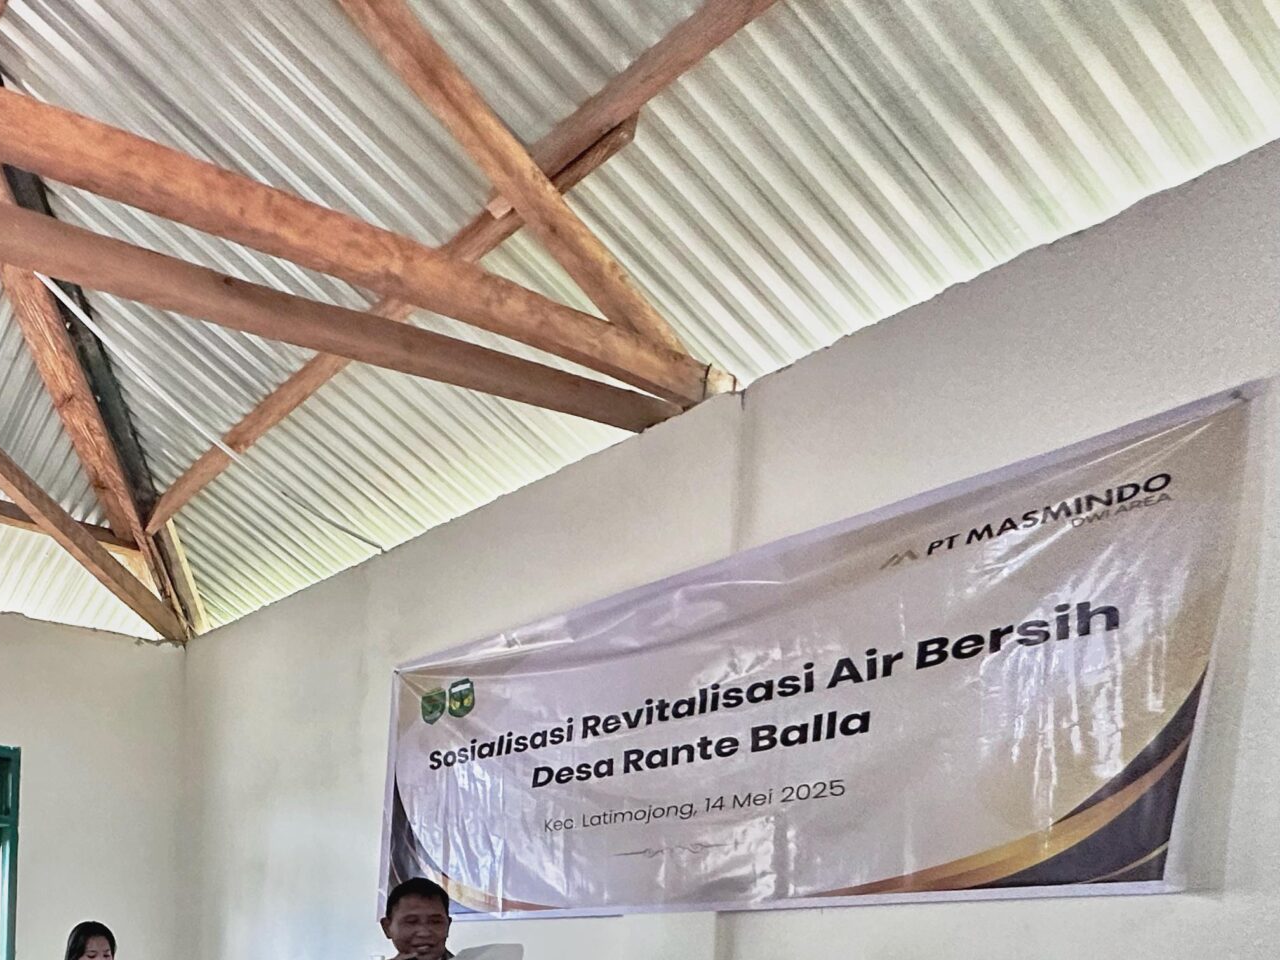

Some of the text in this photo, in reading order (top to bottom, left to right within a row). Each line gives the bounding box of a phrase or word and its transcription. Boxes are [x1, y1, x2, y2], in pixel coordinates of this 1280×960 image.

[926, 473, 1172, 556] PT MASMINDO
[1071, 493, 1172, 529] DWI AREA
[428, 601, 1119, 770] Sosialisasi Revitalisasi Air Bersih
[531, 710, 871, 788] Desa Rante Balla
[582, 799, 699, 828] Latimojong,
[705, 797, 726, 812] 14
[732, 788, 773, 808] Mei
[781, 779, 846, 803] 2025
